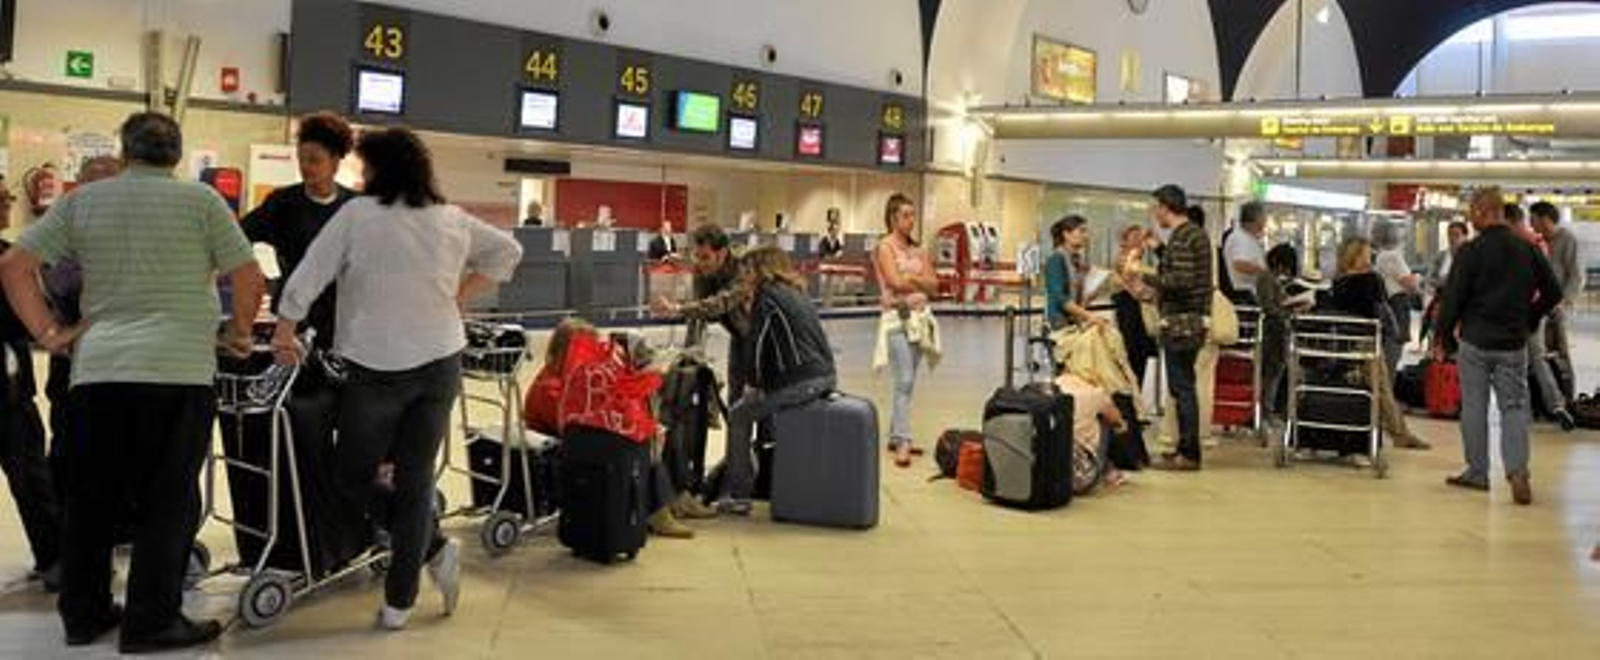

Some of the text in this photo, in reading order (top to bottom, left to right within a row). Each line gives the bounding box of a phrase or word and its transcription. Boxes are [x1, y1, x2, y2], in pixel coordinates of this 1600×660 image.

[364, 24, 404, 58] 43
[524, 50, 558, 81] 44
[620, 66, 649, 94] 45
[732, 83, 758, 109] 46
[801, 93, 823, 118] 47
